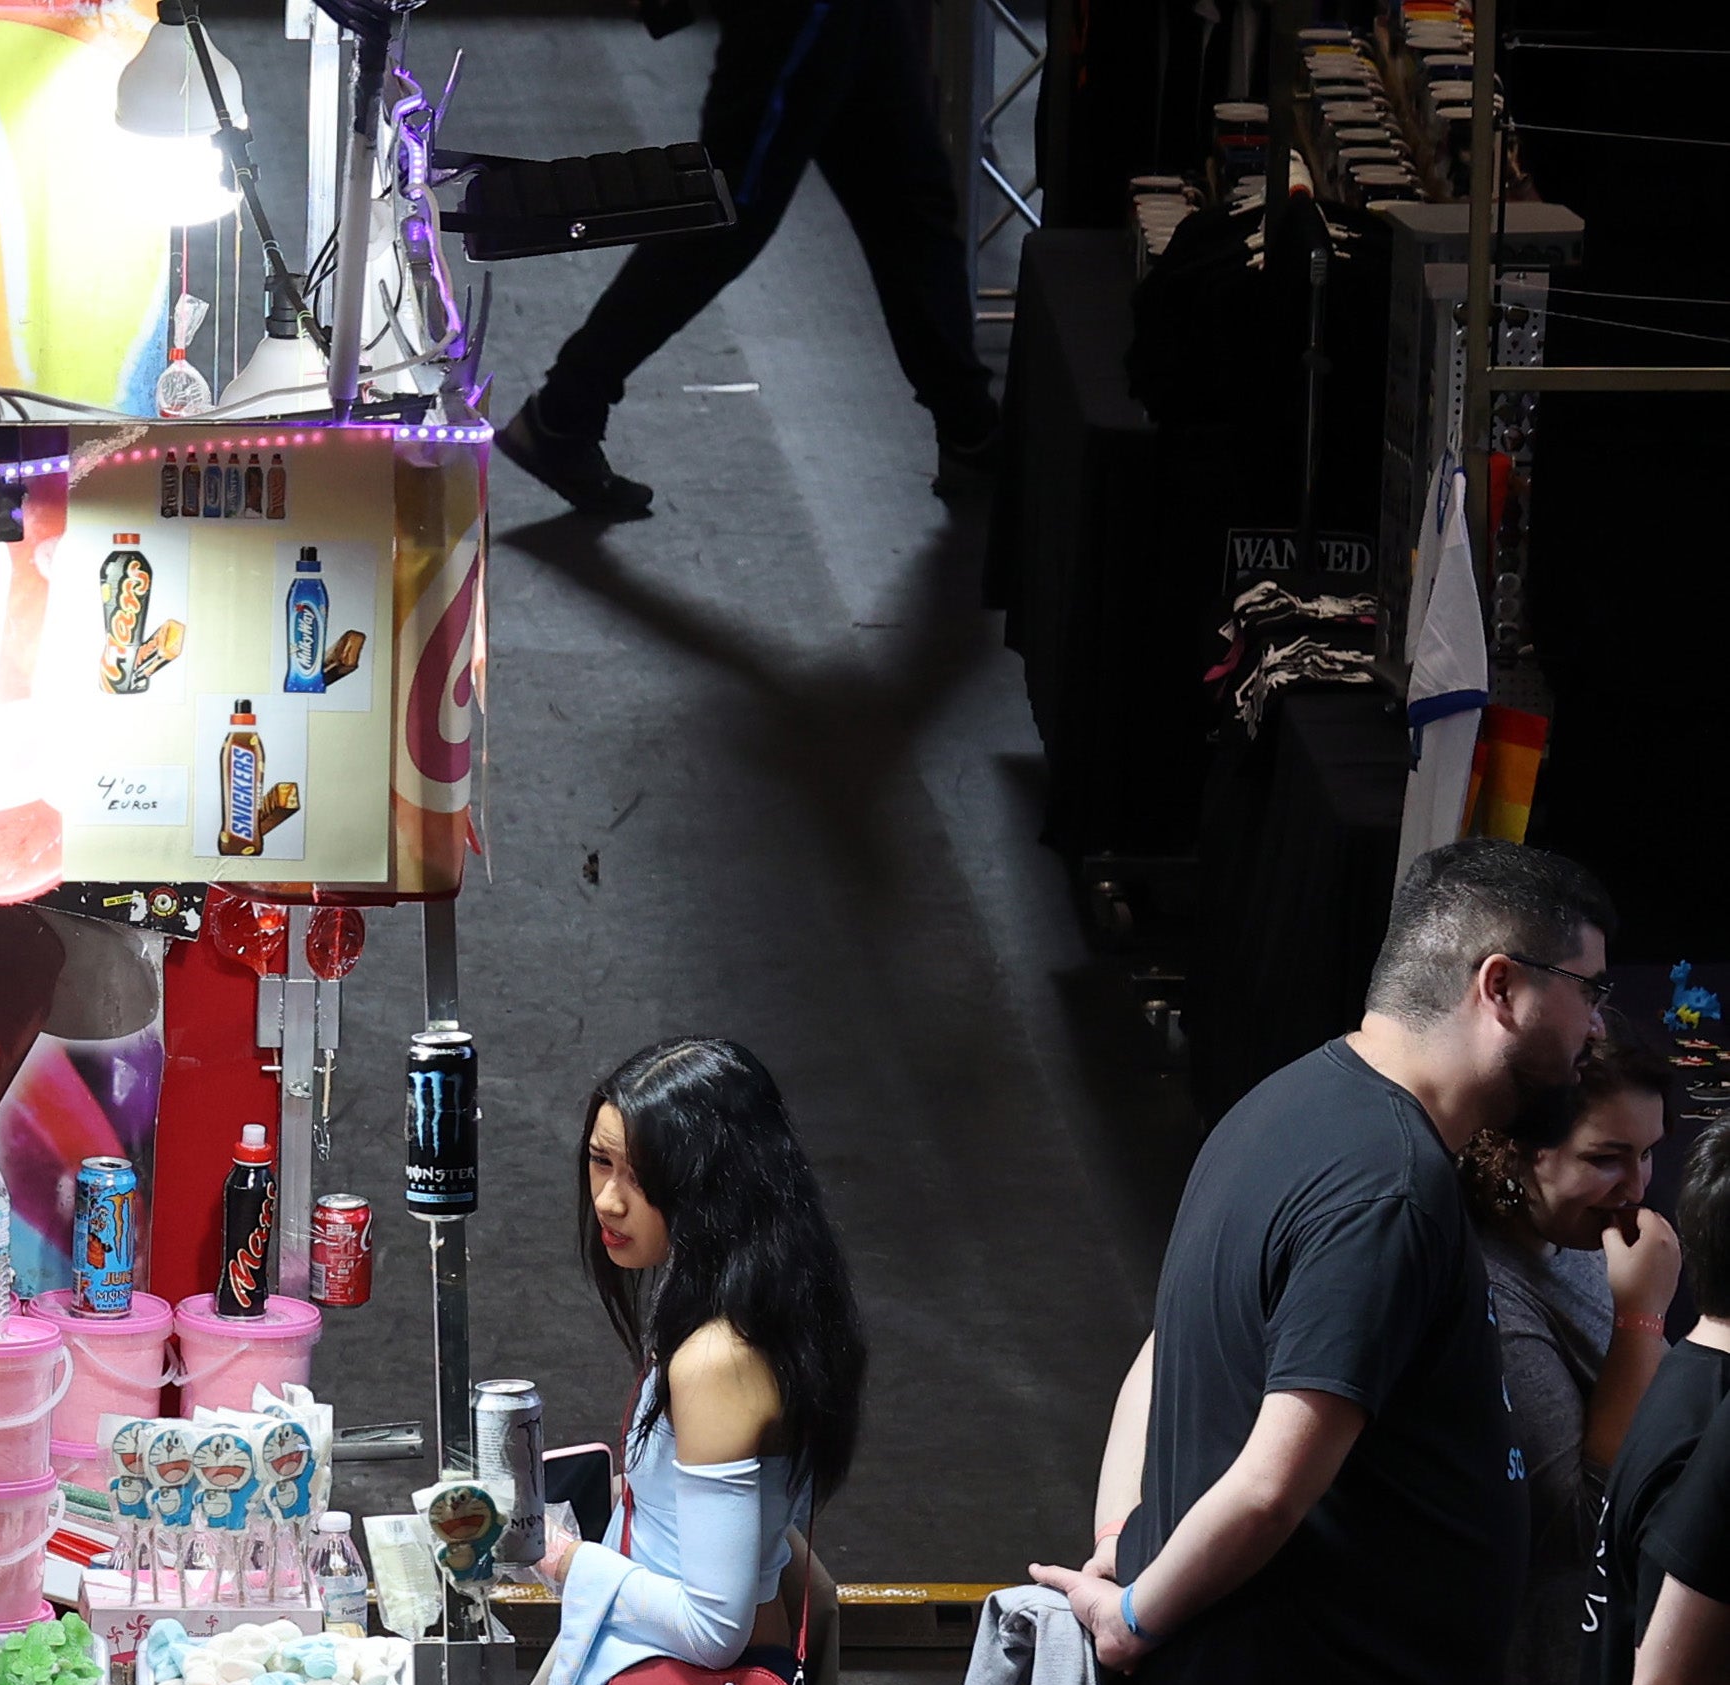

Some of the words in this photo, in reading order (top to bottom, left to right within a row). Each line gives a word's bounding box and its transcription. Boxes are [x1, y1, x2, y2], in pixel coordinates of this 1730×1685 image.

[231, 747, 256, 841] SNICKERS
[108, 799, 158, 811] EUROS
[405, 1164, 476, 1183] MONSTER
